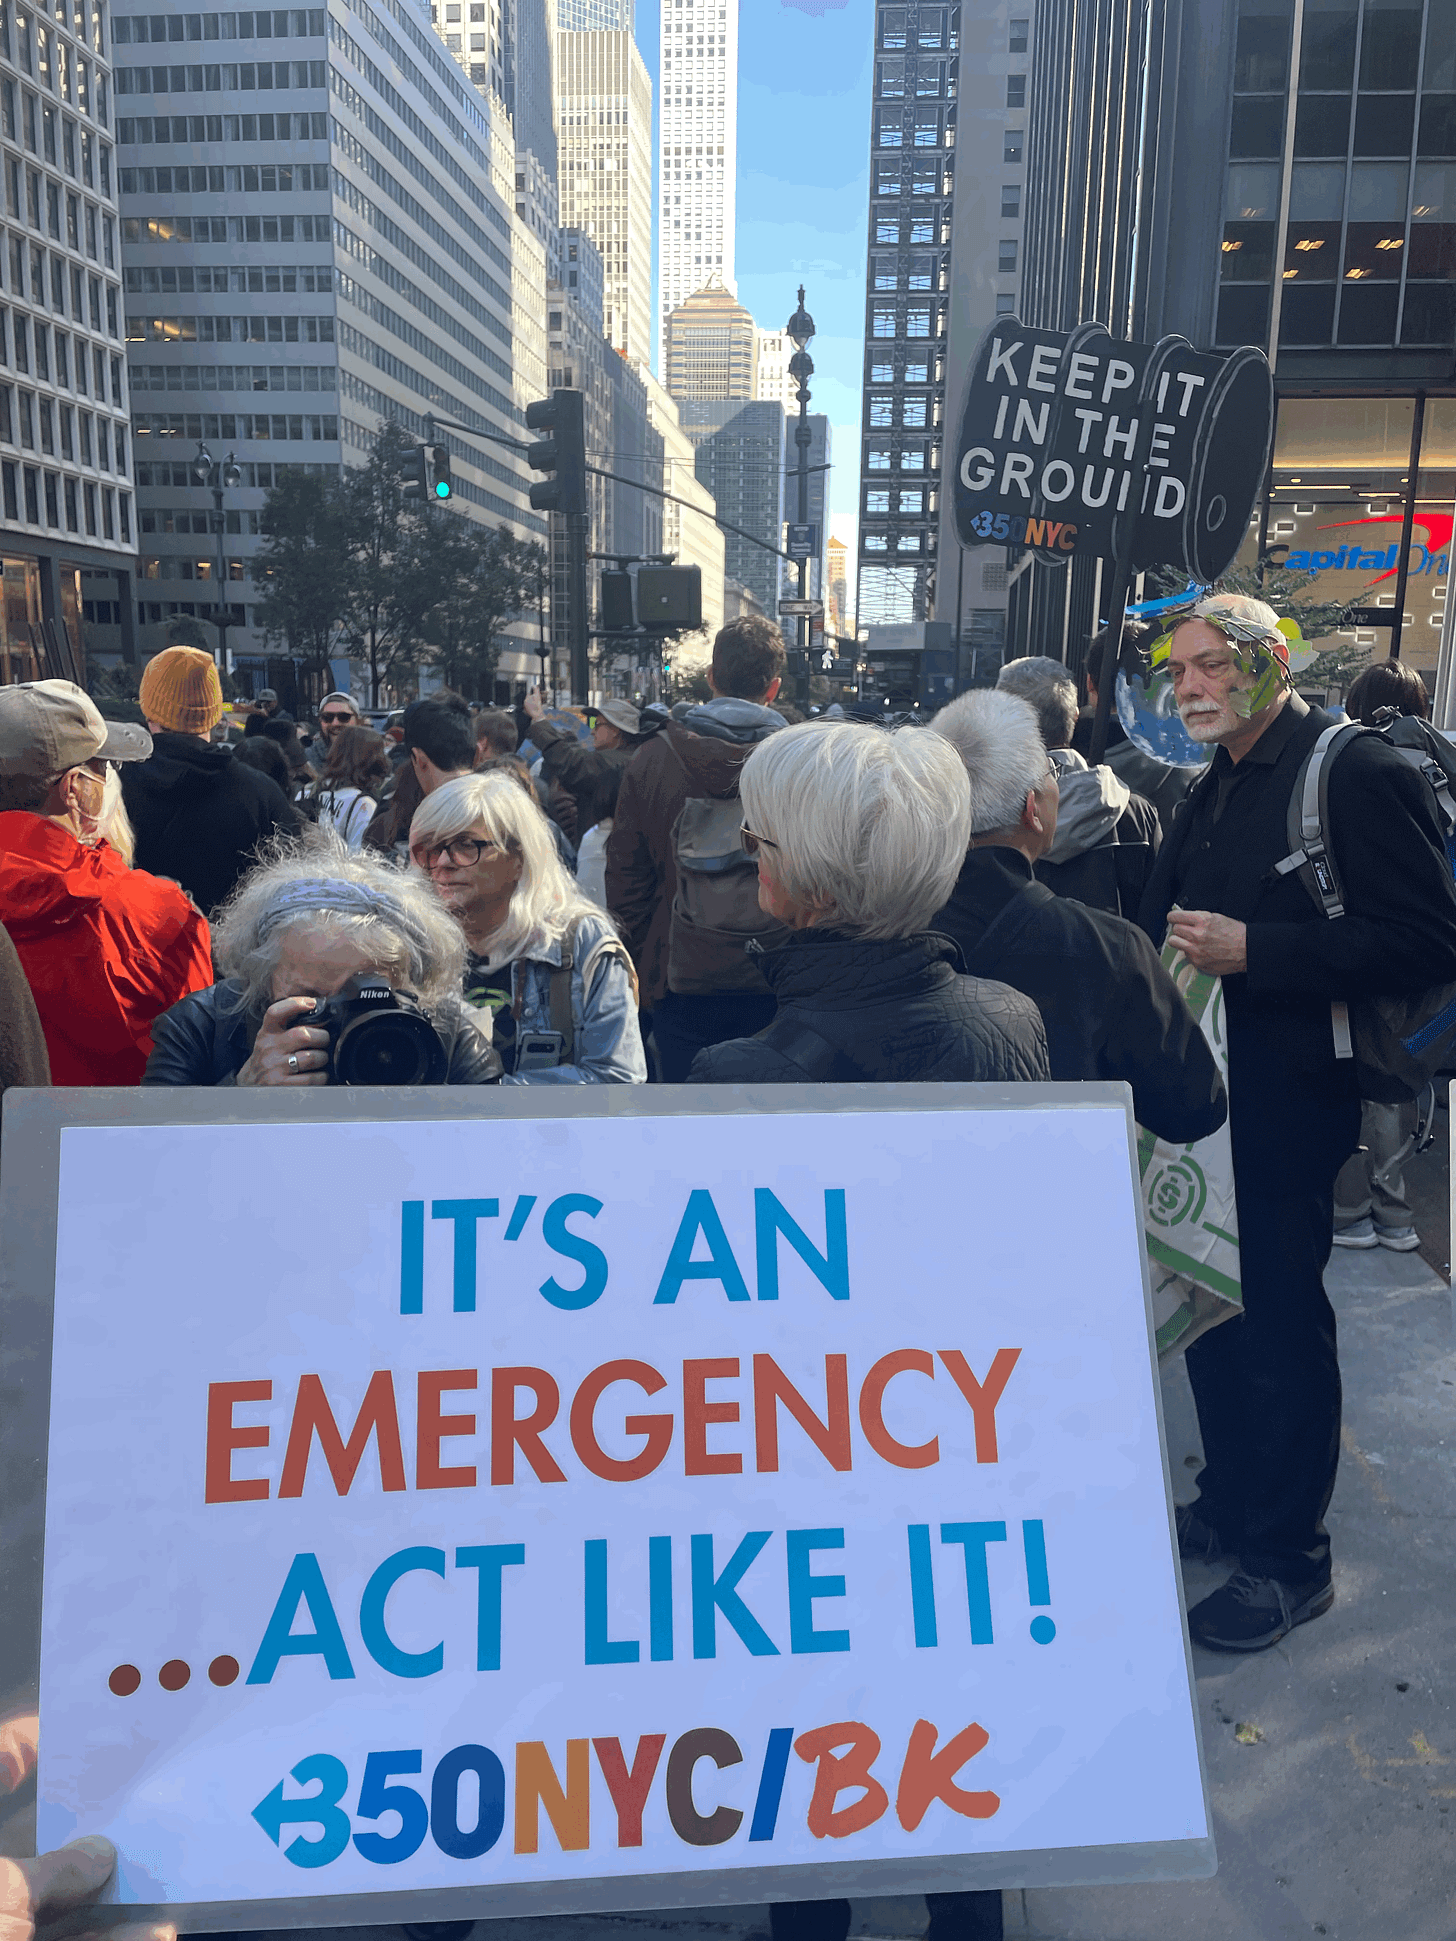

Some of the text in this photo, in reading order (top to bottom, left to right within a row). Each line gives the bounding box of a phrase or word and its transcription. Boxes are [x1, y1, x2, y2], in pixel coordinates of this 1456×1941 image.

[986, 337, 1205, 417] KEEP IT
[993, 395, 1176, 467] IN THE
[970, 510, 1078, 550] 350NYC
[359, 990, 391, 999] Nikon
[400, 1188, 850, 1315] IT'S AN
[206, 1349, 1020, 1503] EMERGENCY
[584, 1528, 850, 1665] LIKE
[908, 1519, 1056, 1648] IT!
